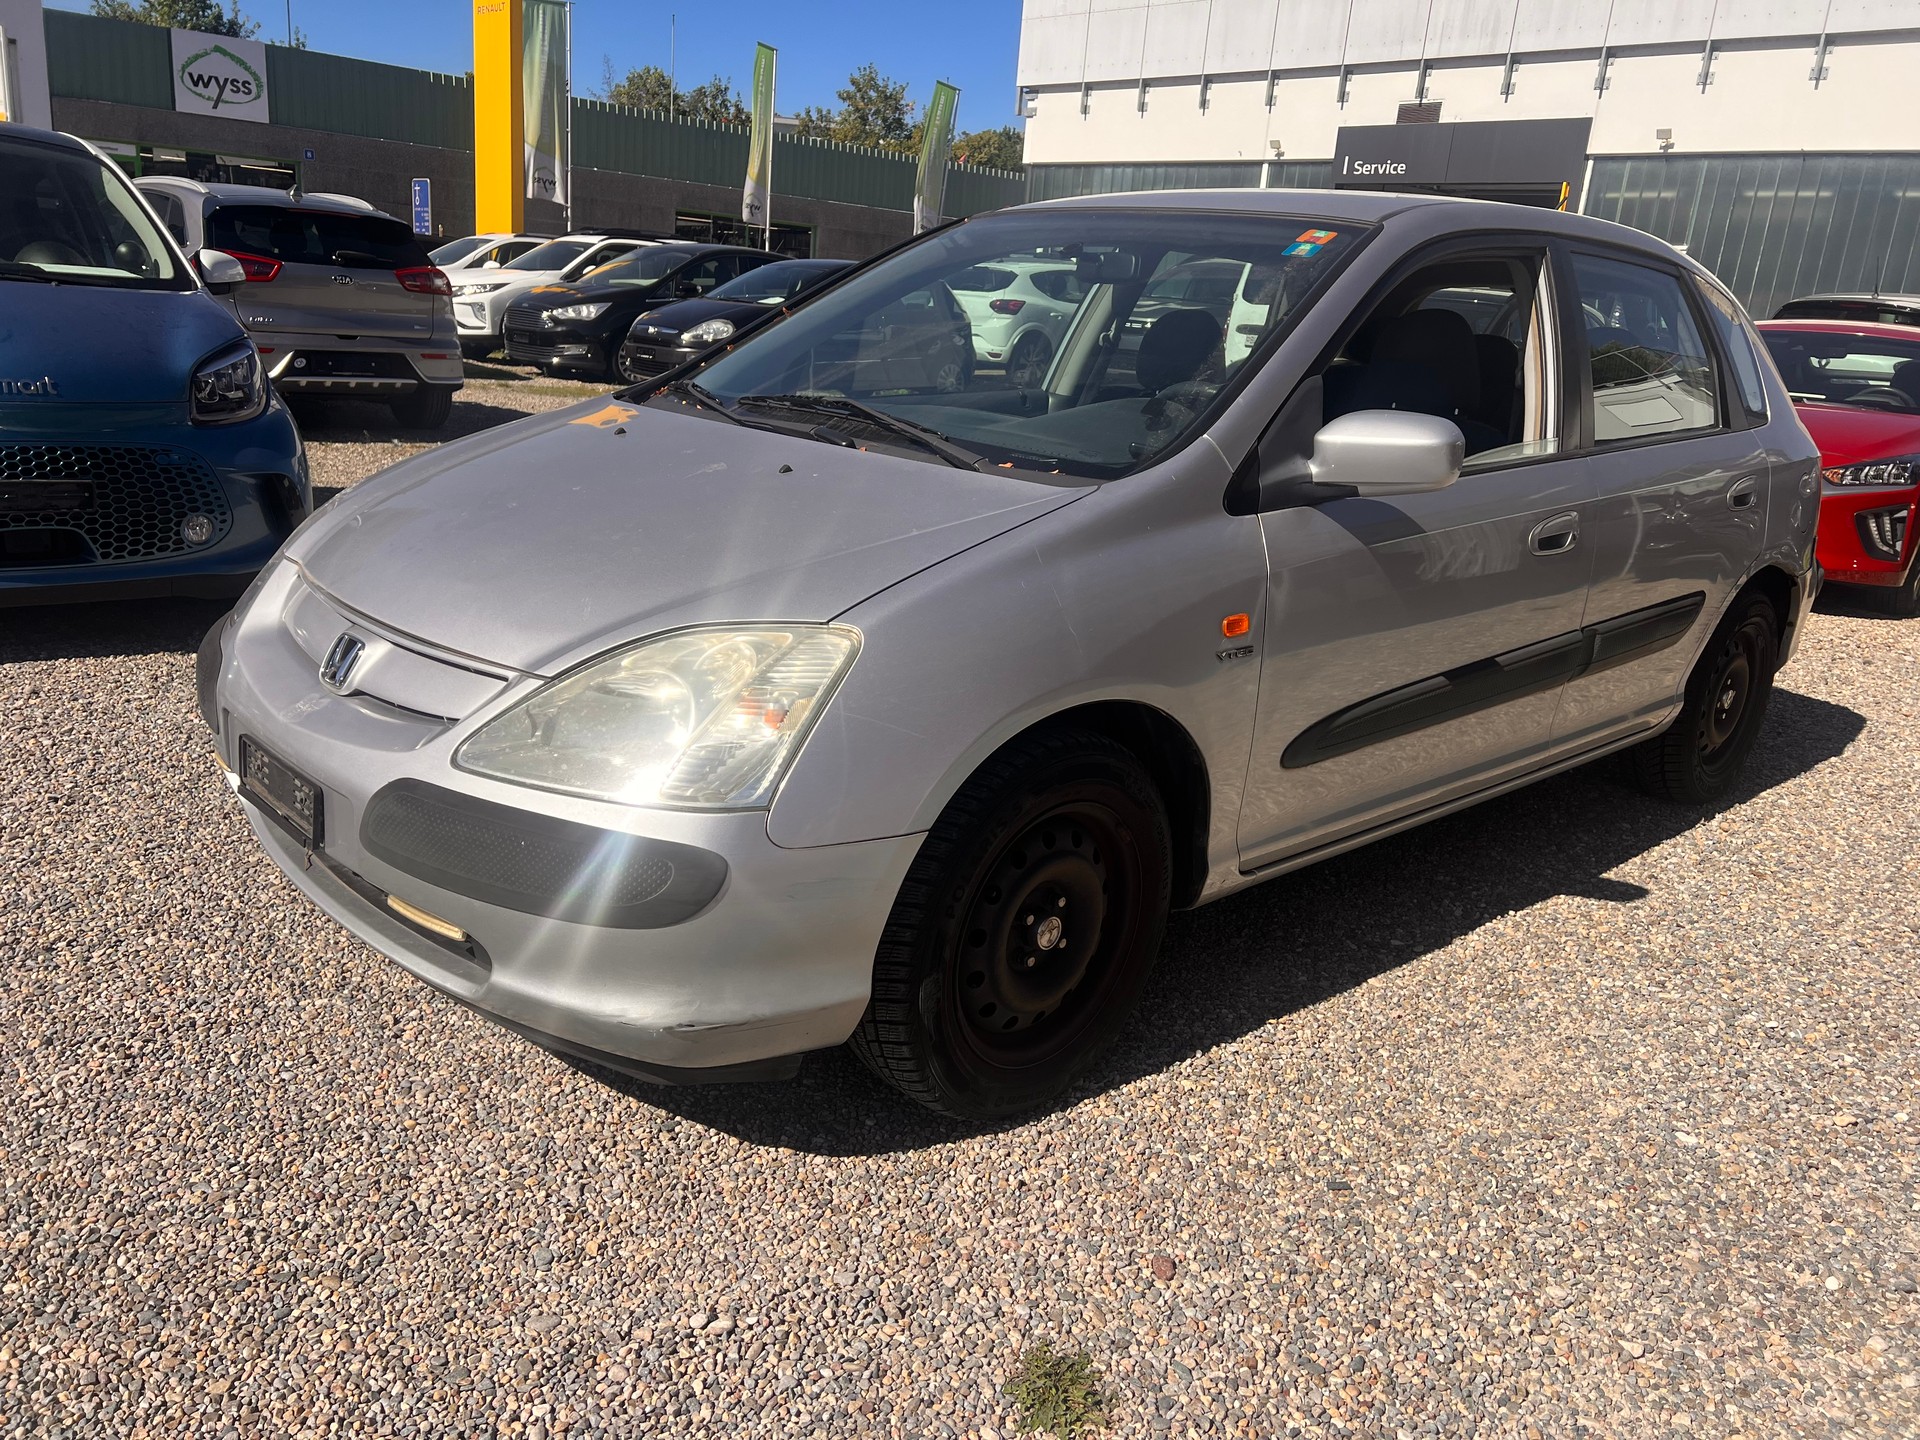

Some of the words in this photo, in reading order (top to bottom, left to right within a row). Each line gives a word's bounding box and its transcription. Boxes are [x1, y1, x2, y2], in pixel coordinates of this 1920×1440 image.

[477, 2, 505, 15] RENAULT
[187, 71, 253, 109] wyss
[1353, 159, 1407, 175] Service
[336, 275, 351, 284] KIA
